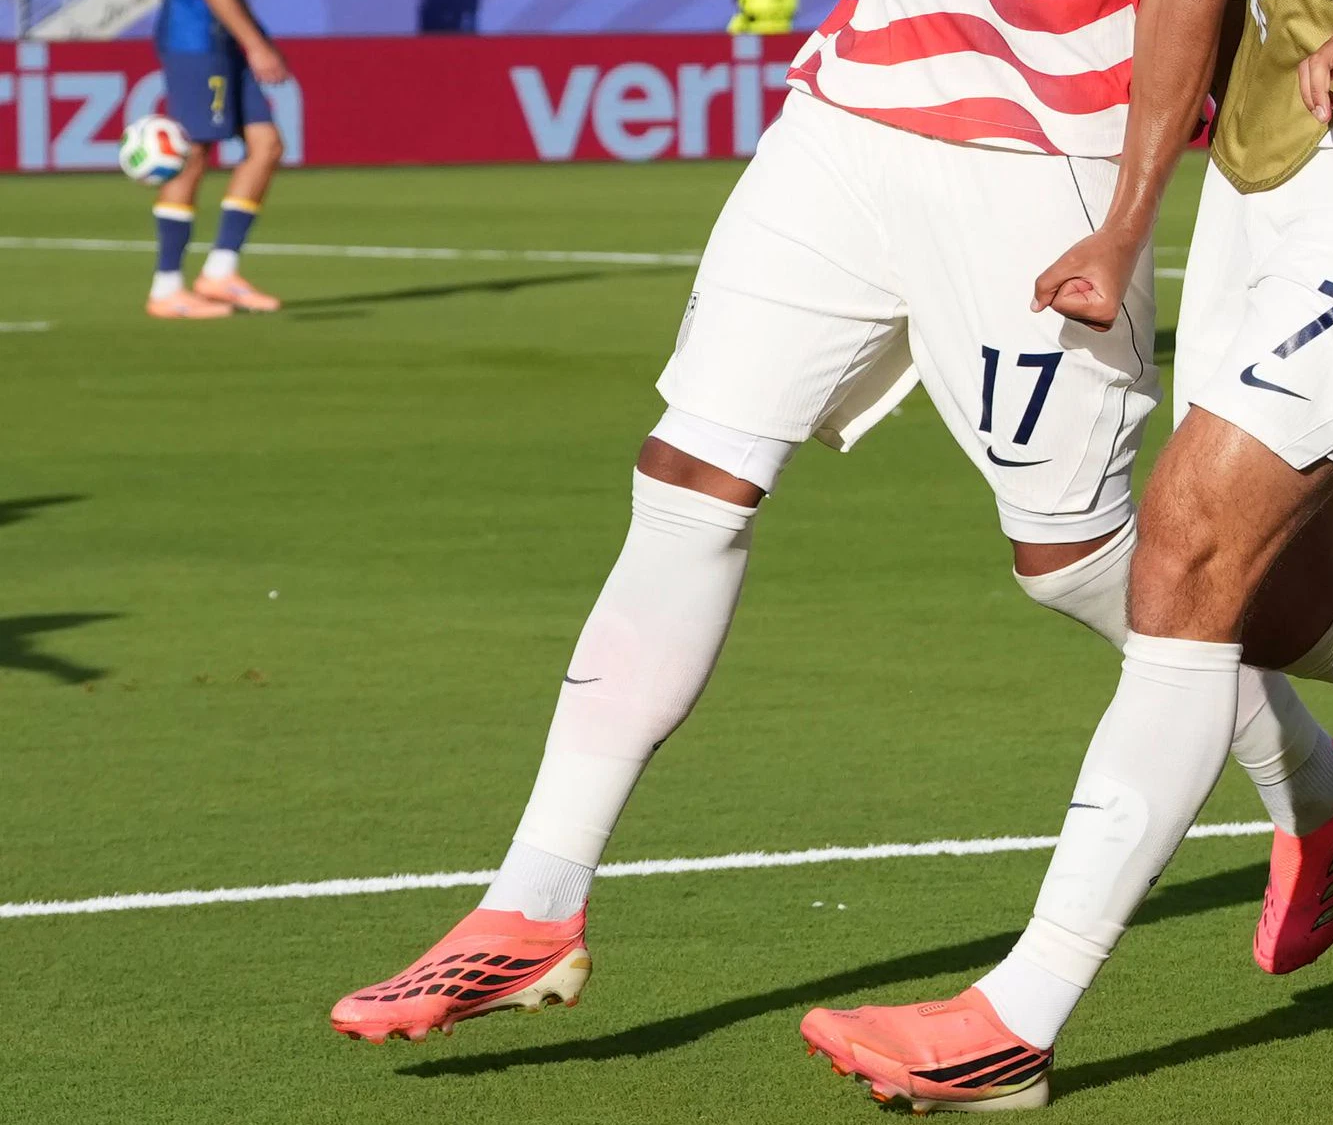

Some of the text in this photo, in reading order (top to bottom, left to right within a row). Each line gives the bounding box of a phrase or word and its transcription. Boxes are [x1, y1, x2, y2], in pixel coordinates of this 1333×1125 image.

[208, 76, 227, 112] 7
[509, 34, 790, 161] veri
[978, 344, 1065, 446] 17
